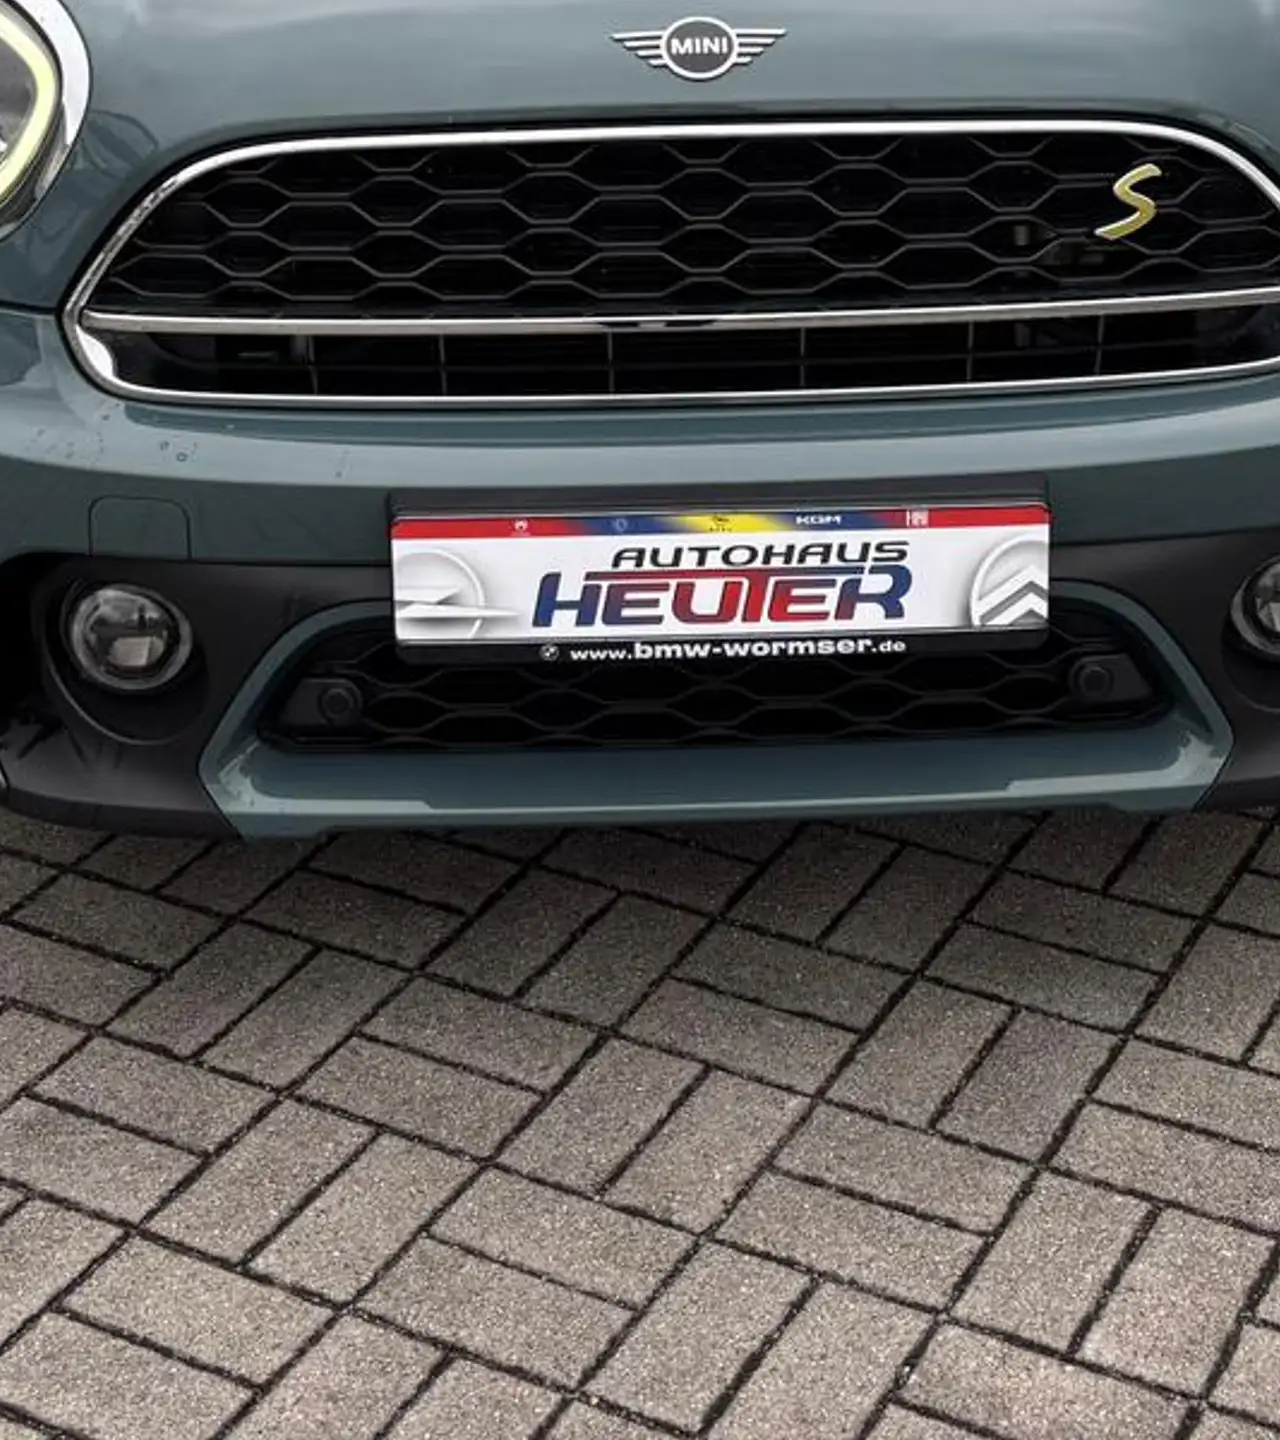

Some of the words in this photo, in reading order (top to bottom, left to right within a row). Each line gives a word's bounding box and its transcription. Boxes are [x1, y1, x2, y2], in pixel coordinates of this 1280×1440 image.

[671, 36, 729, 55] MINI
[1093, 163, 1162, 241] S
[612, 540, 910, 568] AUTOHAUS
[532, 564, 913, 628] HEUTER
[570, 637, 907, 660] www.bmw-wormser.de
